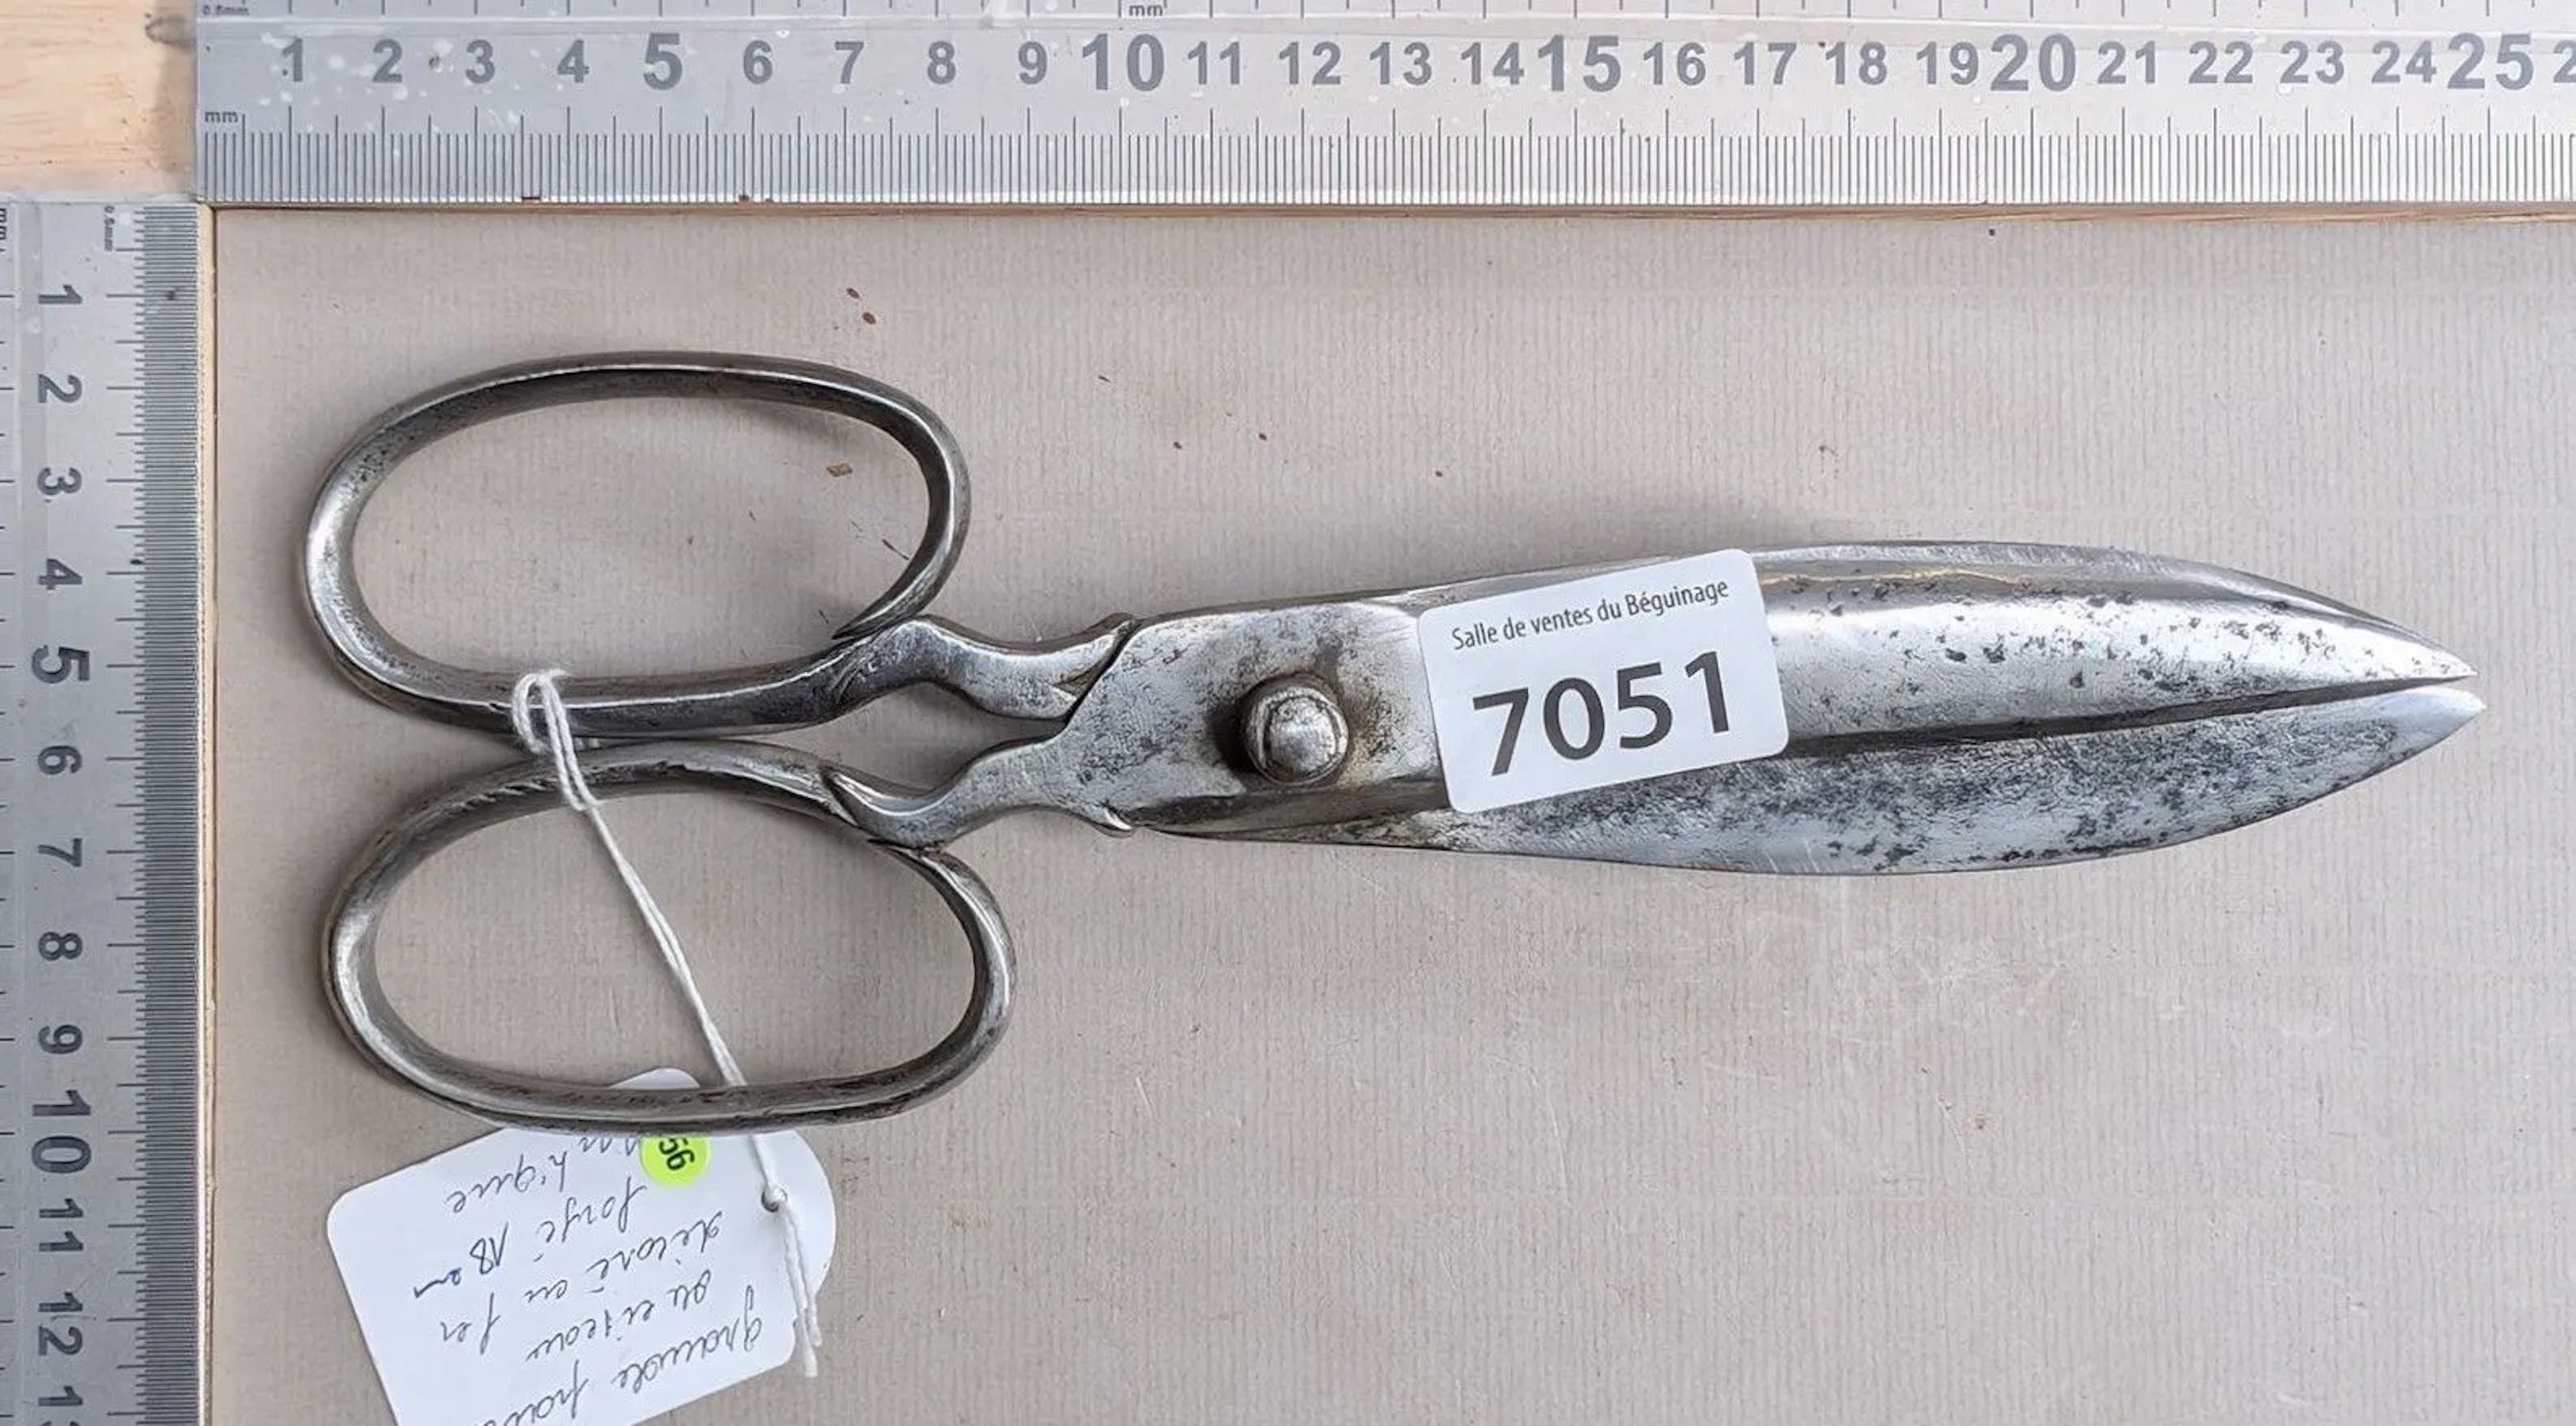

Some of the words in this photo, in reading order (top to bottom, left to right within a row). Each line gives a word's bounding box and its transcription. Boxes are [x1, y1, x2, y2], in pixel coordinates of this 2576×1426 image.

[1129, 5, 1163, 16] mm
[282, 37, 303, 82] 1
[372, 39, 402, 83] 2
[466, 40, 495, 84] 3
[557, 40, 589, 83] 4
[643, 32, 682, 90] 5
[743, 40, 773, 85] 6
[835, 41, 864, 85] 7
[927, 41, 956, 85] 8
[1018, 41, 1048, 85] 9
[1081, 34, 1165, 91] 10
[1187, 41, 1240, 85] 11
[1279, 42, 1341, 85] 12
[1370, 42, 1432, 86] 13
[1461, 42, 1524, 85] 14
[1538, 35, 1621, 92] 15
[1643, 42, 1706, 86] 16
[1733, 42, 1797, 85] 17
[1825, 42, 1887, 86] 18
[1917, 42, 1979, 85] 19
[1990, 33, 2076, 92] 20
[2097, 41, 2156, 85] 21
[2188, 41, 2253, 85] 22
[2280, 40, 2344, 85] 23
[2371, 40, 2436, 84] 24
[2447, 32, 2534, 90] 25
[2553, 40, 2576, 84] 2
[205, 111, 237, 123] mm
[38, 284, 83, 305] 1
[38, 373, 82, 403] 2
[37, 466, 82, 496] 3
[38, 558, 83, 590] 4
[1452, 623, 1499, 651] Salle
[1503, 616, 1527, 640] de
[1532, 607, 1593, 635] ventes
[1597, 598, 1622, 622] du
[1625, 580, 1729, 616] Béguinage
[32, 644, 90, 683] 5
[1472, 651, 1729, 777] 7051
[37, 745, 83, 775] 6
[38, 838, 83, 868] 7
[38, 932, 83, 961] 8
[38, 1024, 83, 1054] 9
[32, 1090, 91, 1174] 10
[39, 1198, 84, 1252] 11
[523, 1279, 568, 1303] en
[668, 1269, 711, 1310] de
[38, 1292, 83, 1356] 12
[440, 1292, 500, 1355] fer
[612, 1285, 763, 1393] grande
[38, 1386, 83, 1426] 1
